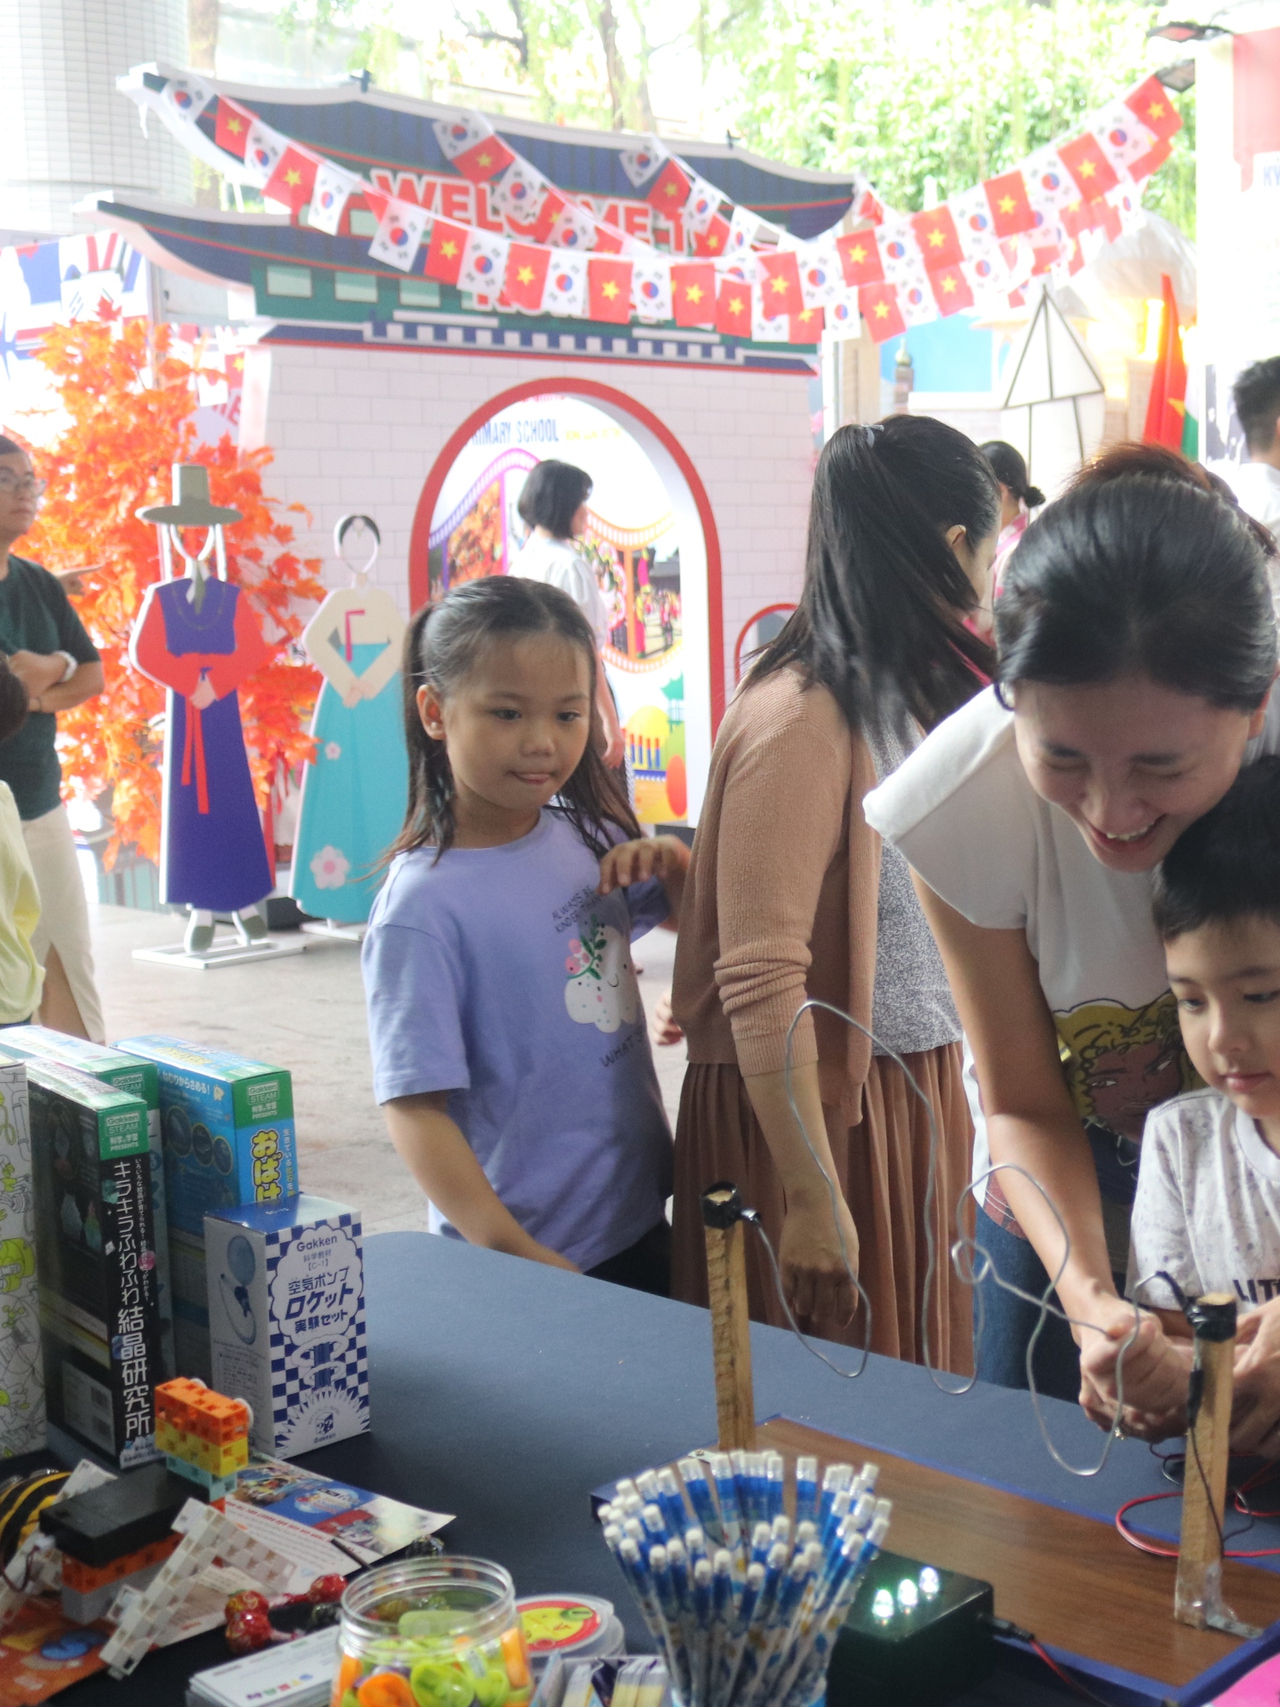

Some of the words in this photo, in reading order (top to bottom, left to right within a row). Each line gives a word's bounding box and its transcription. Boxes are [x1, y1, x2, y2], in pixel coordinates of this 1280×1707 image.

[516, 418, 560, 444] SCHOOL
[249, 1081, 278, 1095] Gakken
[250, 1091, 278, 1103] STEAM
[106, 1113, 139, 1126] Gakken
[108, 1123, 139, 1135] STEAM
[296, 1235, 338, 1252] Gakken
[288, 1265, 350, 1296] 空気ポンプ
[113, 1161, 151, 1439] キラキラふわふわ結晶研究所
[285, 1282, 354, 1320] ロケット
[294, 1309, 348, 1334] 実験セット
[313, 1432, 337, 1444] Gakken
